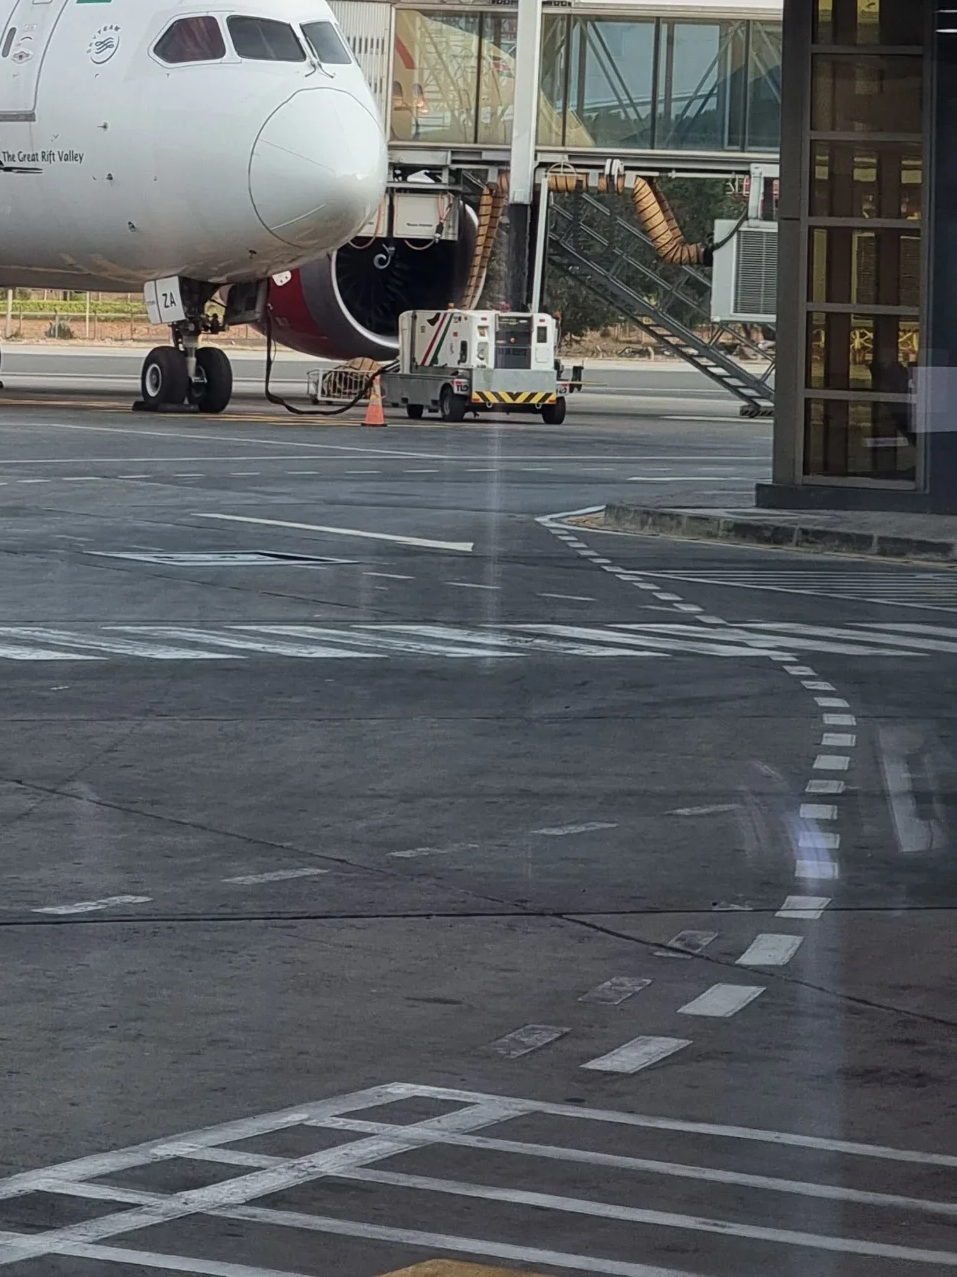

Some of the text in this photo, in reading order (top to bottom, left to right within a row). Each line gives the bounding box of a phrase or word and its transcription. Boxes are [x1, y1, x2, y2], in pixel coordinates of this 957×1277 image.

[2, 149, 84, 164] The Great Rift Valley
[162, 291, 177, 309] ZA
